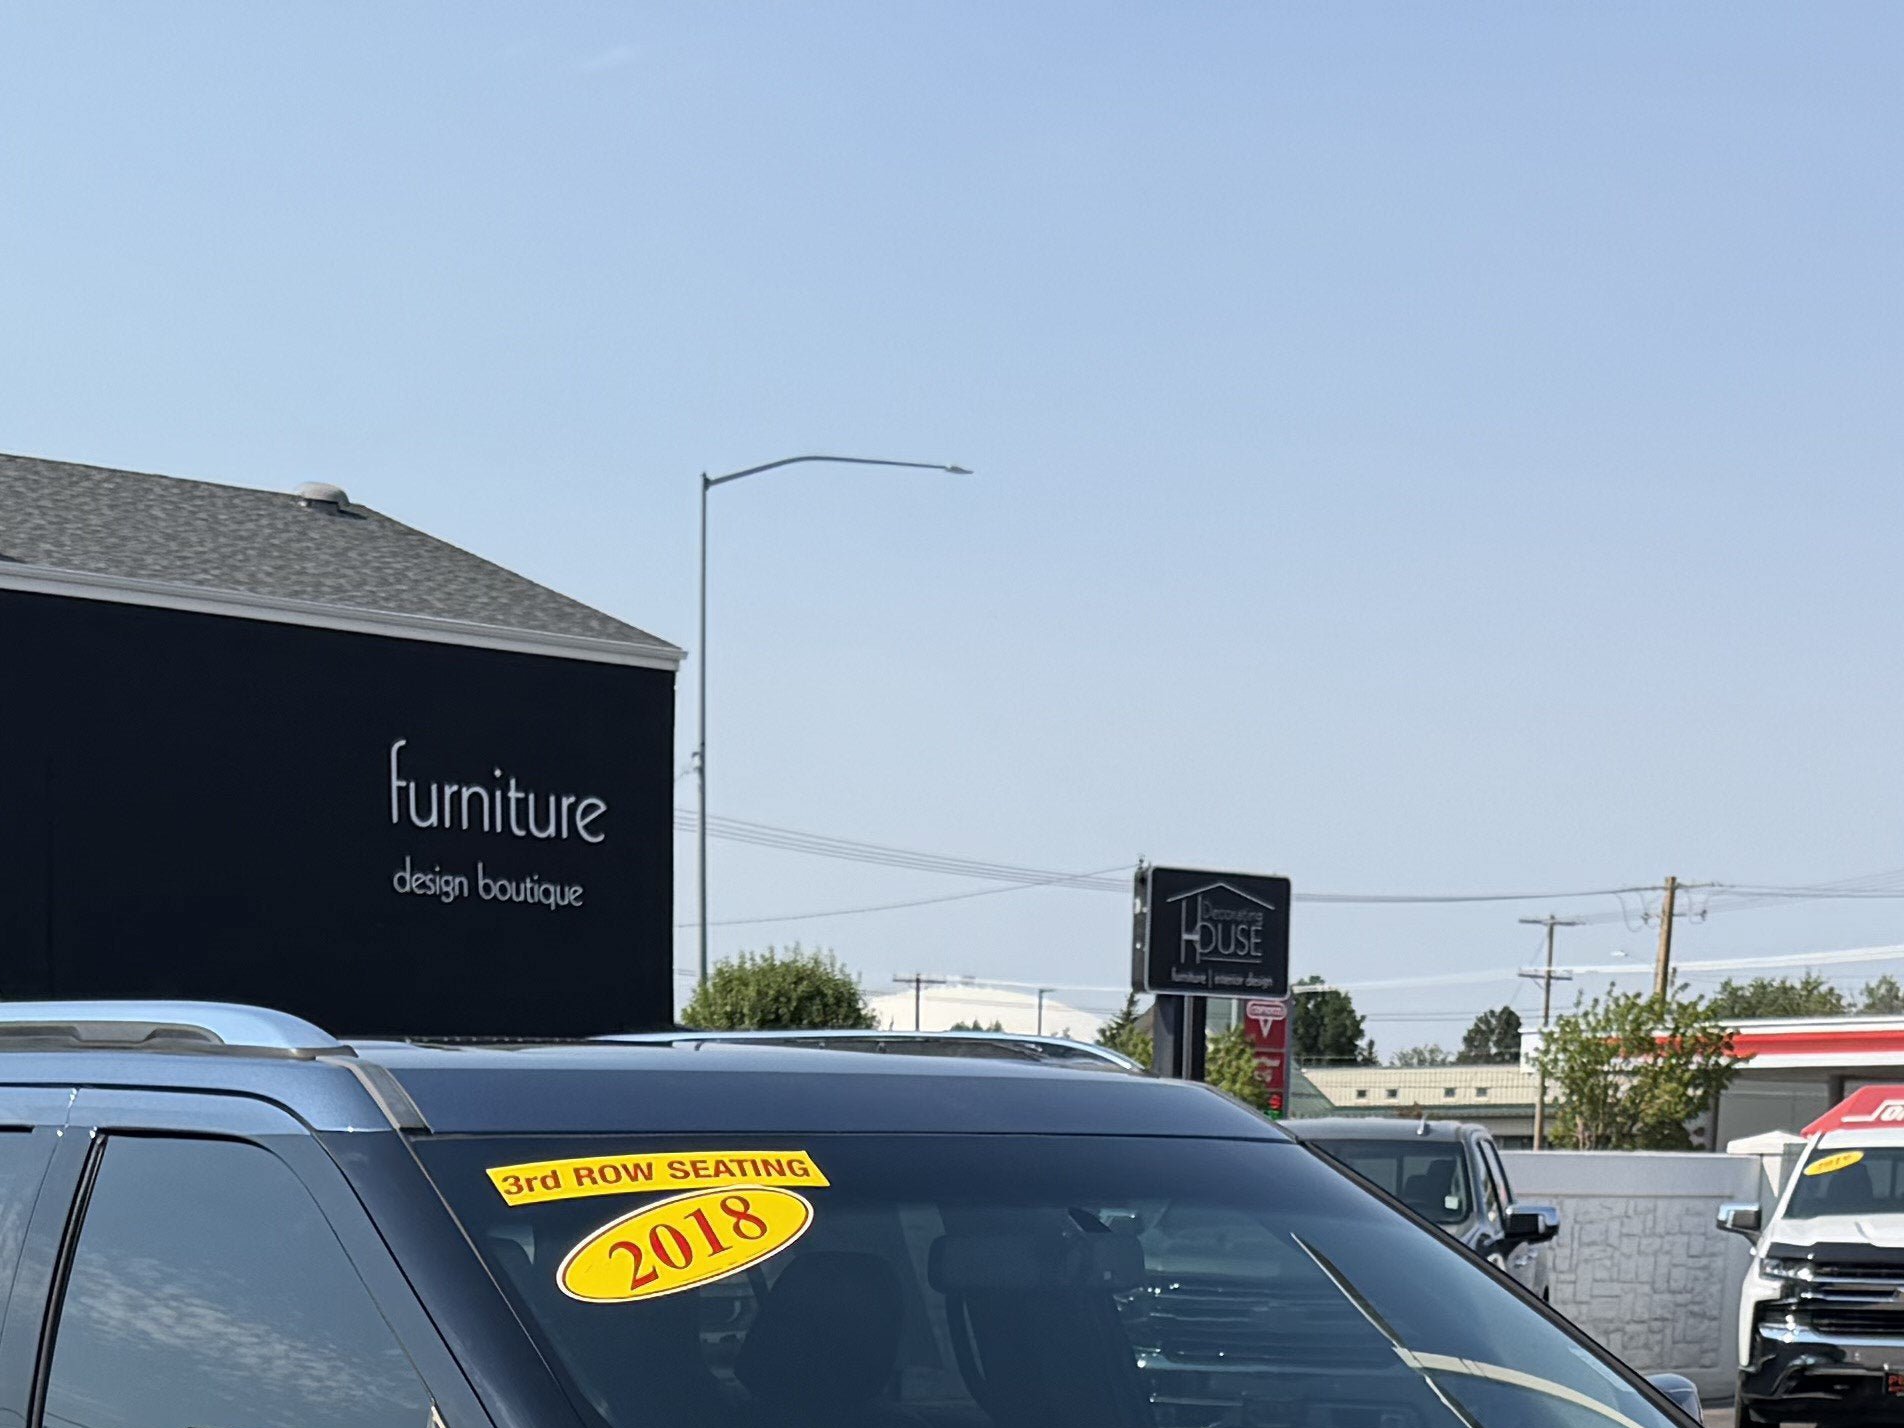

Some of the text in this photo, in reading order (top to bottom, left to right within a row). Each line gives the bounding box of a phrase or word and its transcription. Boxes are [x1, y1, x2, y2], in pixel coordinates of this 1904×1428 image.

[391, 739, 607, 843] furniture
[393, 855, 584, 911] design boutique
[1180, 894, 1263, 964] HOUSE
[502, 1157, 812, 1197] 3rd ROW SEATING
[608, 1194, 770, 1292] 2018
